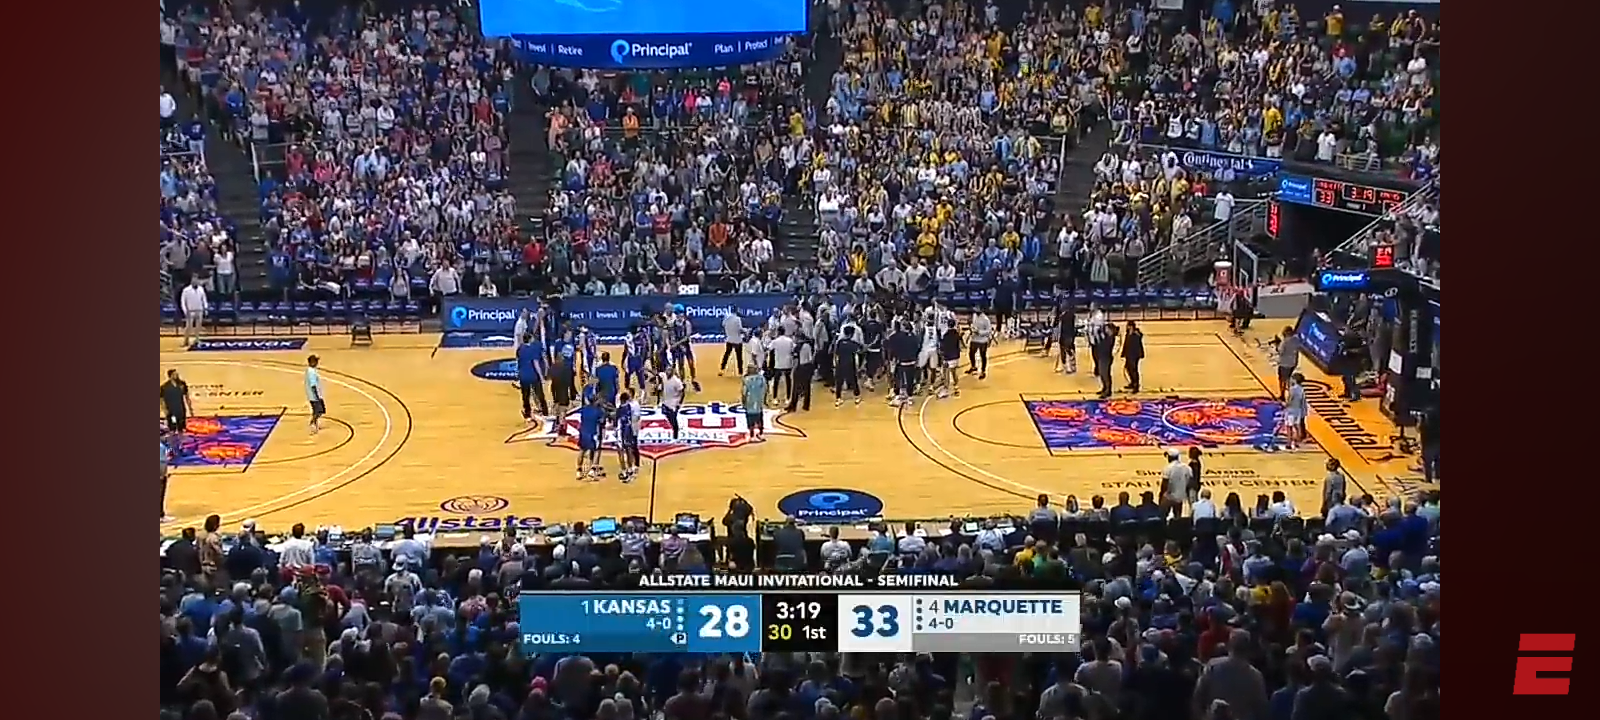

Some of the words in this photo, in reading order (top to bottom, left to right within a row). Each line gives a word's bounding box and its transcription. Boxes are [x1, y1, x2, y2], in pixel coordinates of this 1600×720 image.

[558, 44, 583, 56] Retire
[632, 43, 690, 58] Principal
[715, 44, 734, 54] Plan
[745, 39, 768, 51] Protect
[468, 309, 516, 322] Principal
[1239, 479, 1318, 487] CENTER
[798, 508, 865, 517] Principal
